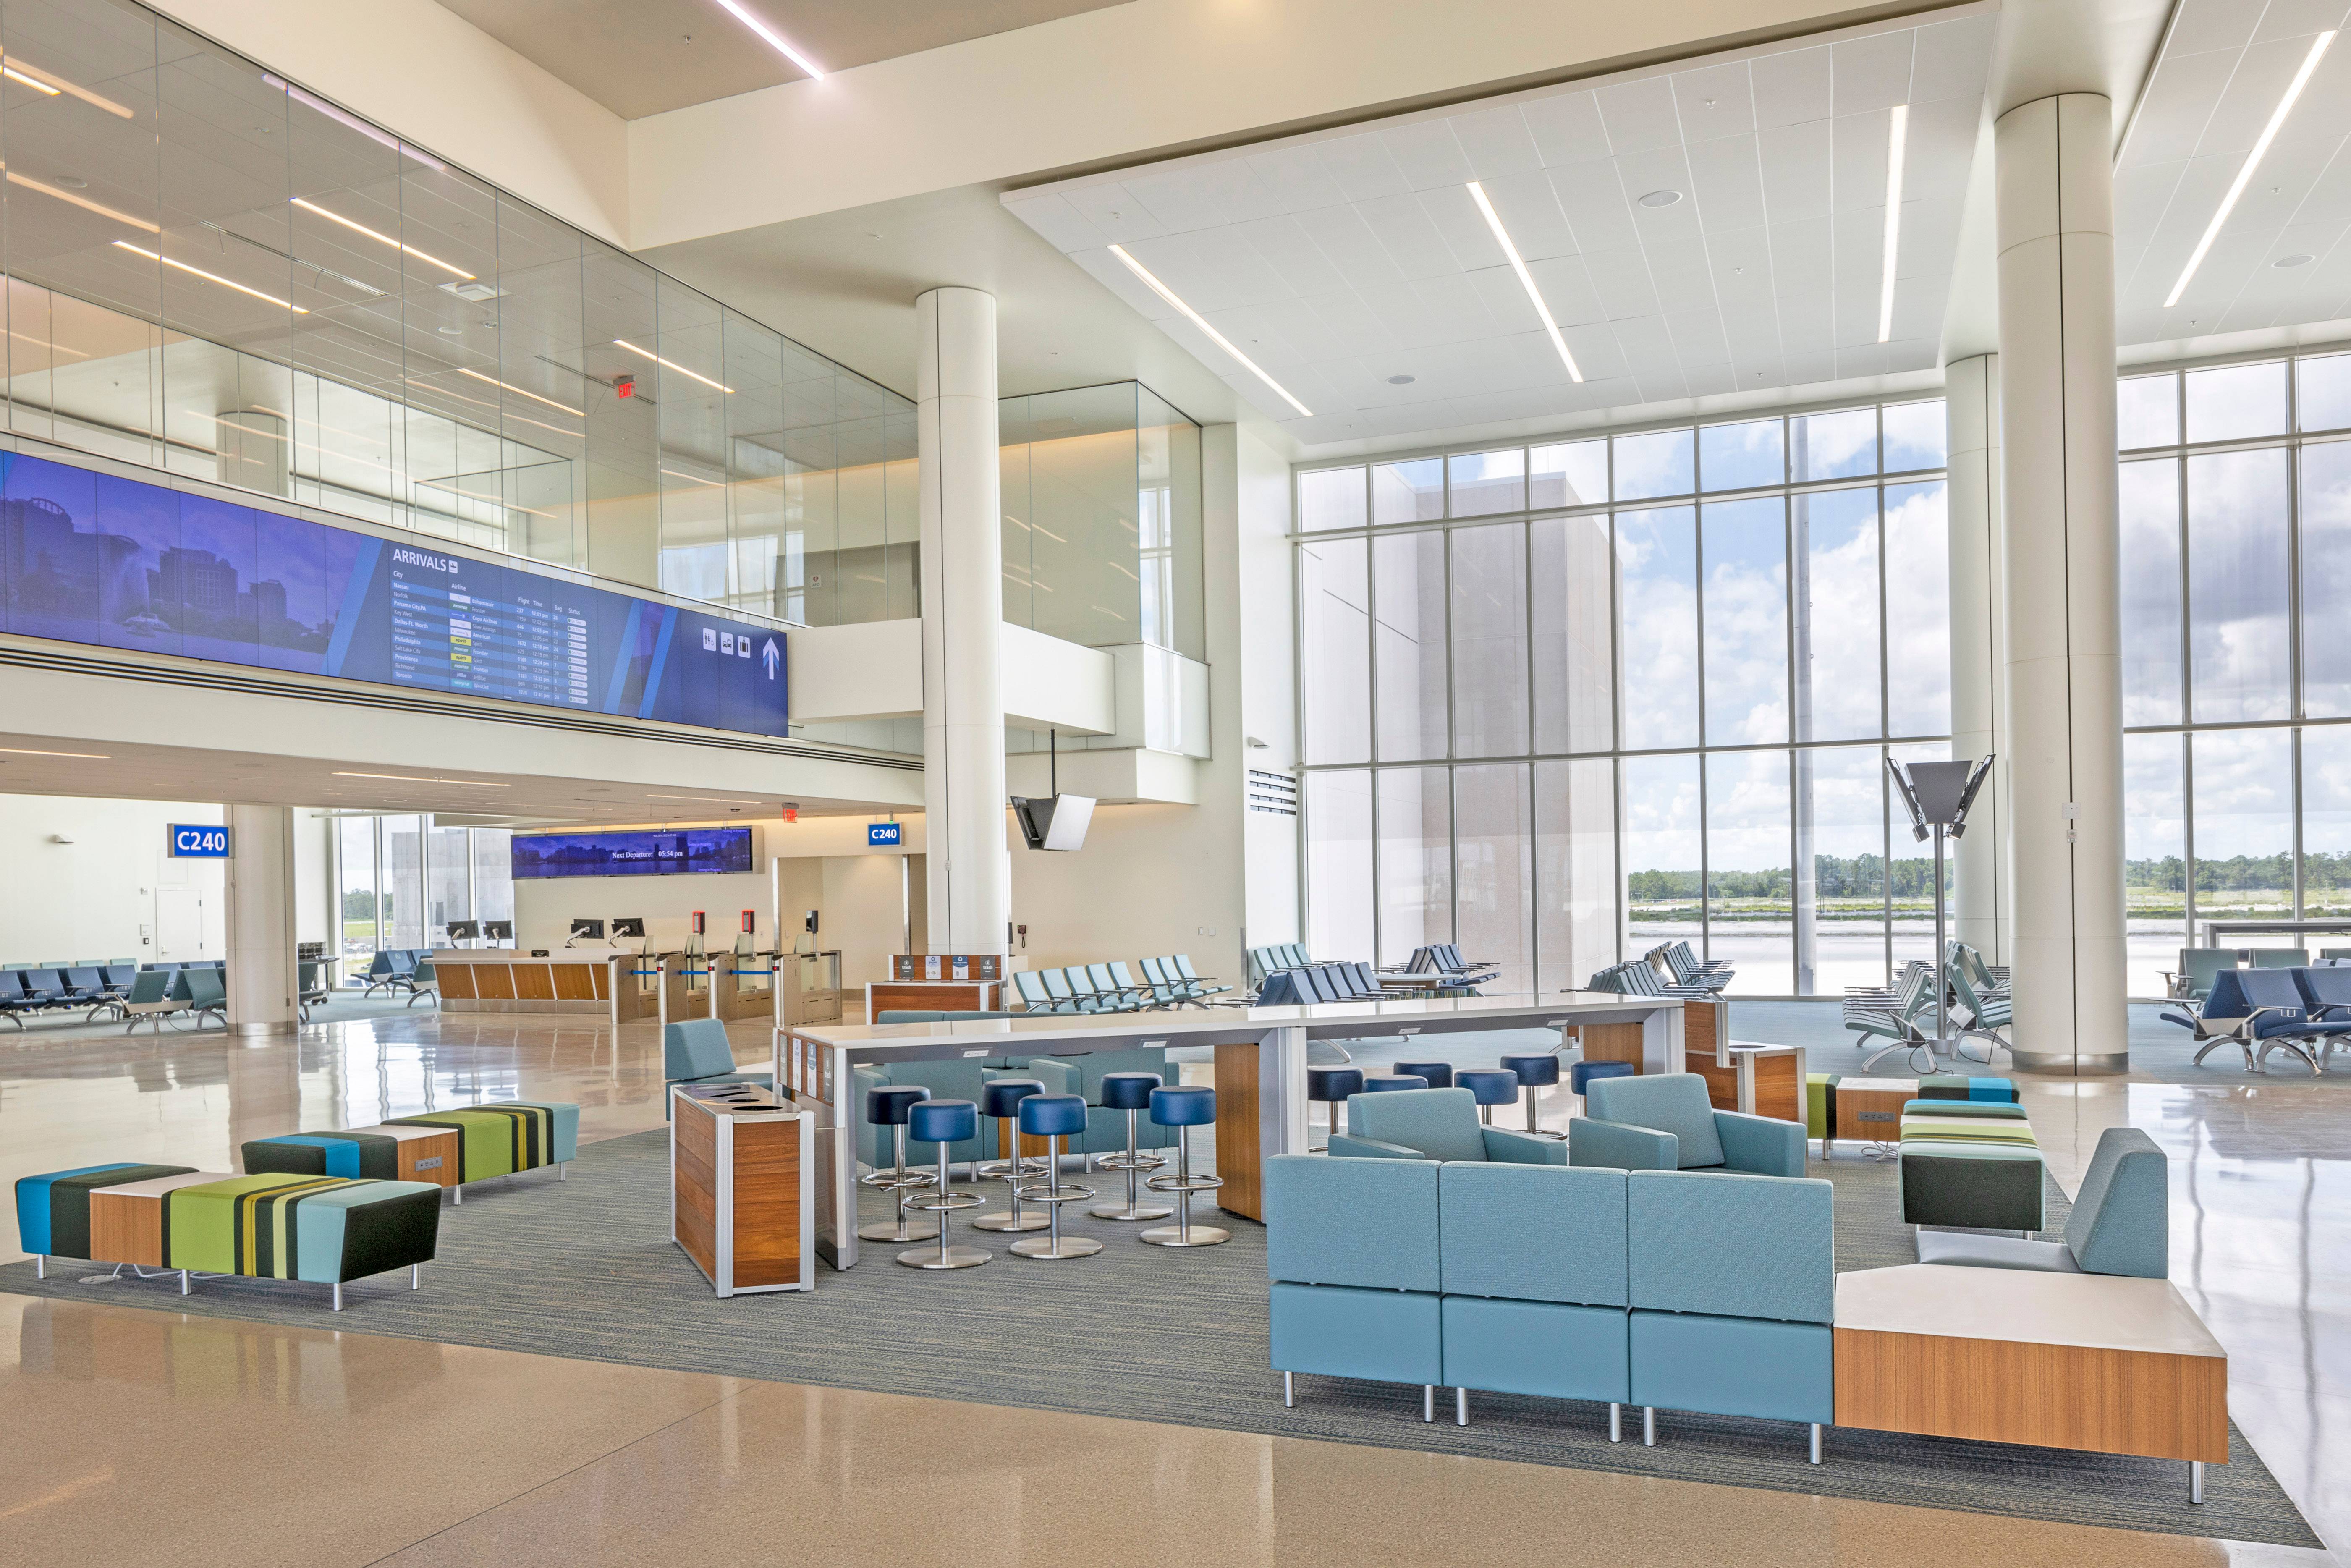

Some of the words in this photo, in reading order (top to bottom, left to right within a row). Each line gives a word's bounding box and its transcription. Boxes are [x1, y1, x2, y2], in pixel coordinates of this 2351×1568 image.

[619, 383, 631, 398] EXIT
[393, 549, 446, 571] ARRIVALS
[472, 599, 494, 607] Bahamasair
[395, 636, 421, 644] Philadelphia
[786, 809, 796, 821] EXIT
[872, 829, 897, 839] C240
[178, 832, 225, 851] C240
